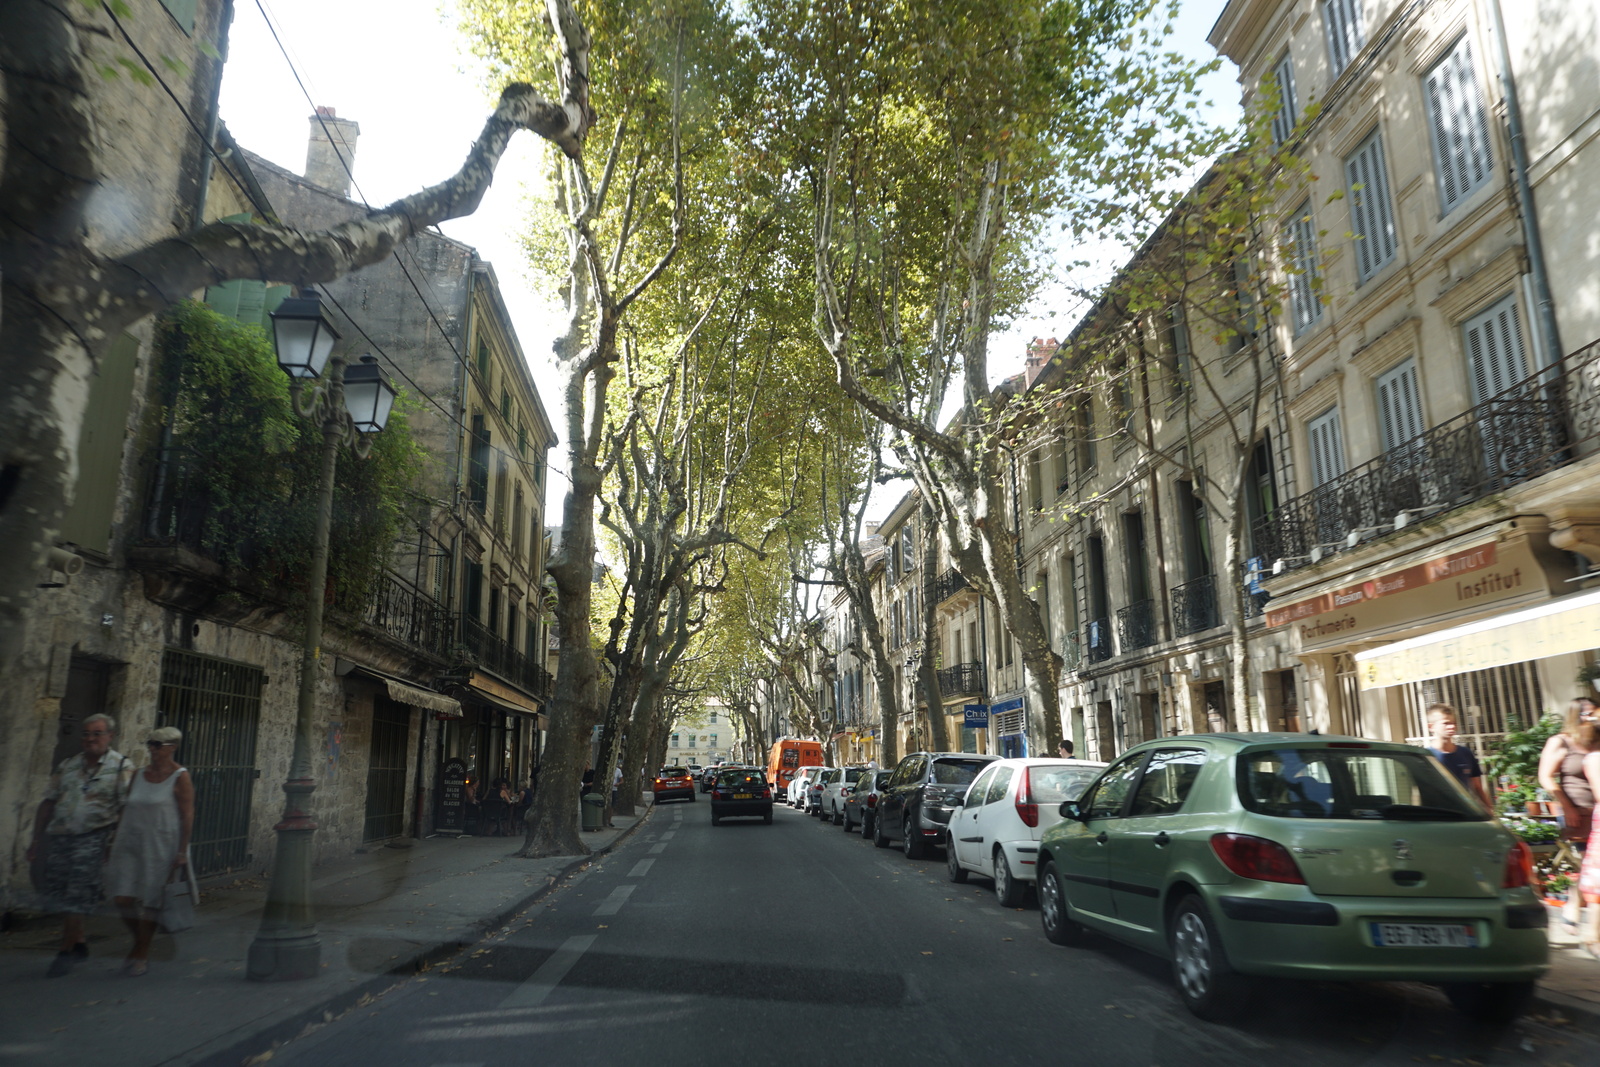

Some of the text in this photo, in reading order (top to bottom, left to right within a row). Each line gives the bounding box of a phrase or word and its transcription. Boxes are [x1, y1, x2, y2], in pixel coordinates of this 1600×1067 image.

[1430, 551, 1485, 578] INSTITUT
[1301, 567, 1522, 640] Parfumerie Institut
